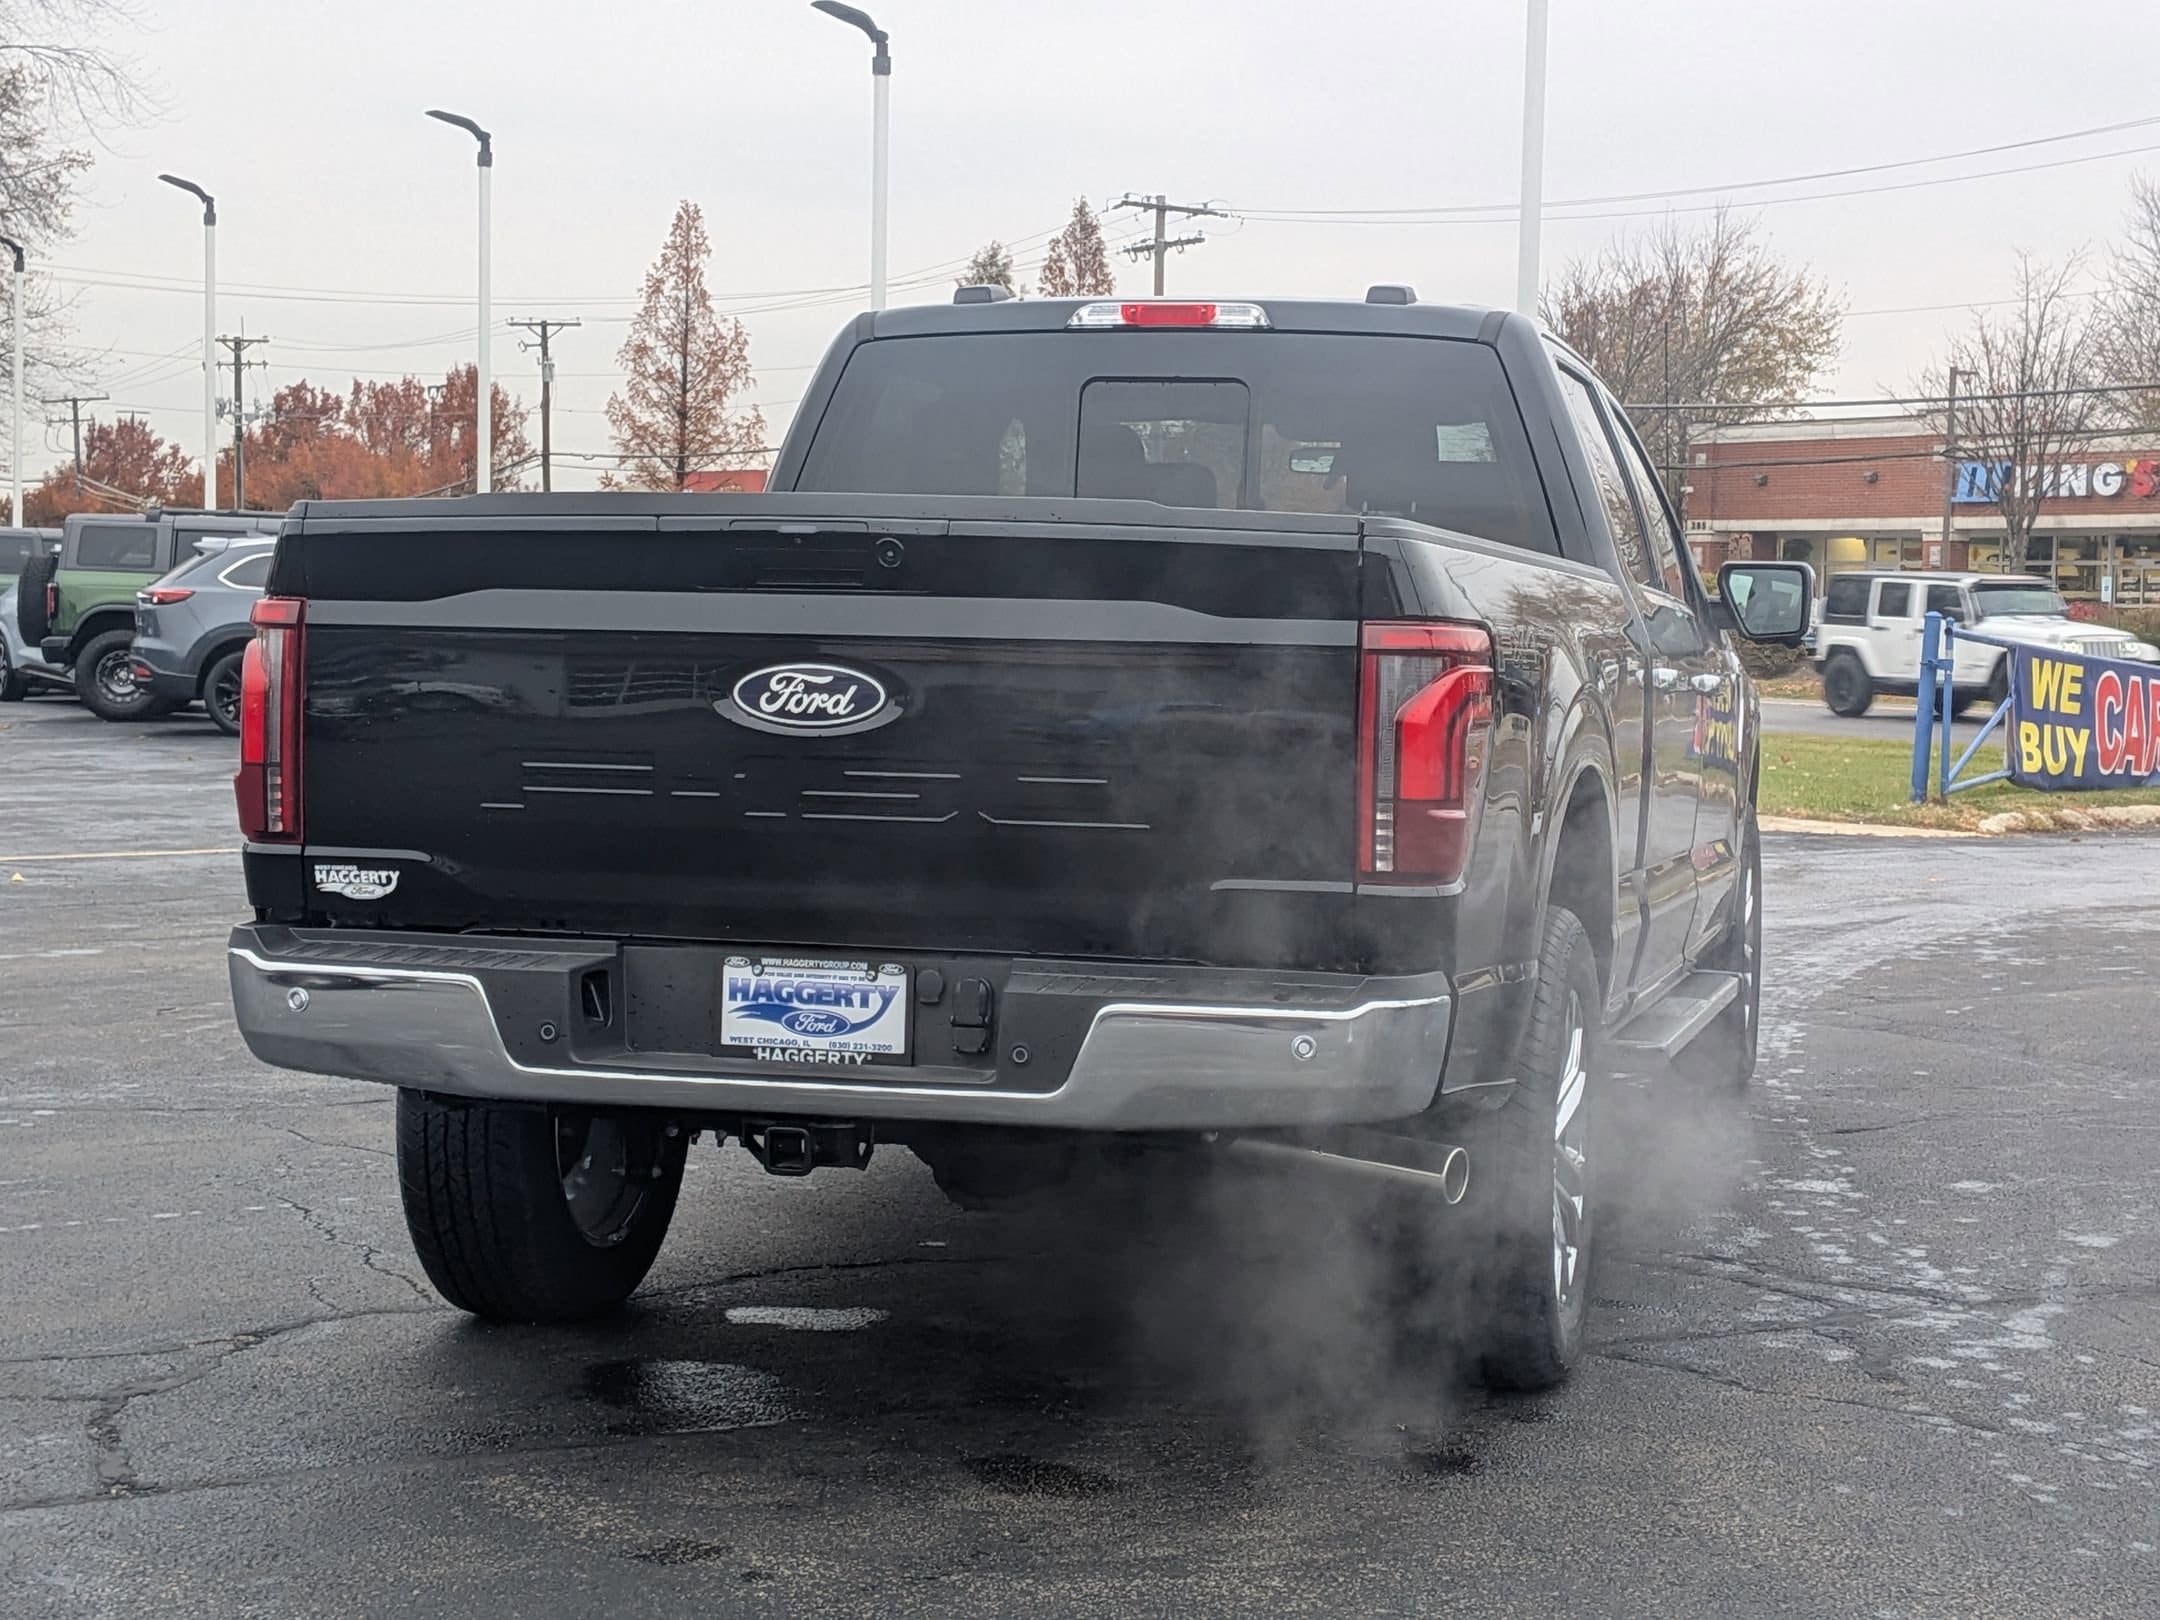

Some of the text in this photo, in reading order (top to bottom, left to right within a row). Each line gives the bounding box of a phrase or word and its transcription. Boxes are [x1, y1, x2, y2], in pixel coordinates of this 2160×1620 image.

[760, 672, 857, 715] Ford
[2032, 657, 2084, 715] WE
[2019, 720, 2090, 777] BUY
[314, 870, 400, 885] HAGGERTY
[728, 977, 900, 1009] HAGGERTY
[795, 1014, 836, 1033] Ford
[729, 1036, 754, 1044] WEST
[756, 1037, 800, 1047] CHICAGO,
[757, 1047, 866, 1066] HAGGERTY
